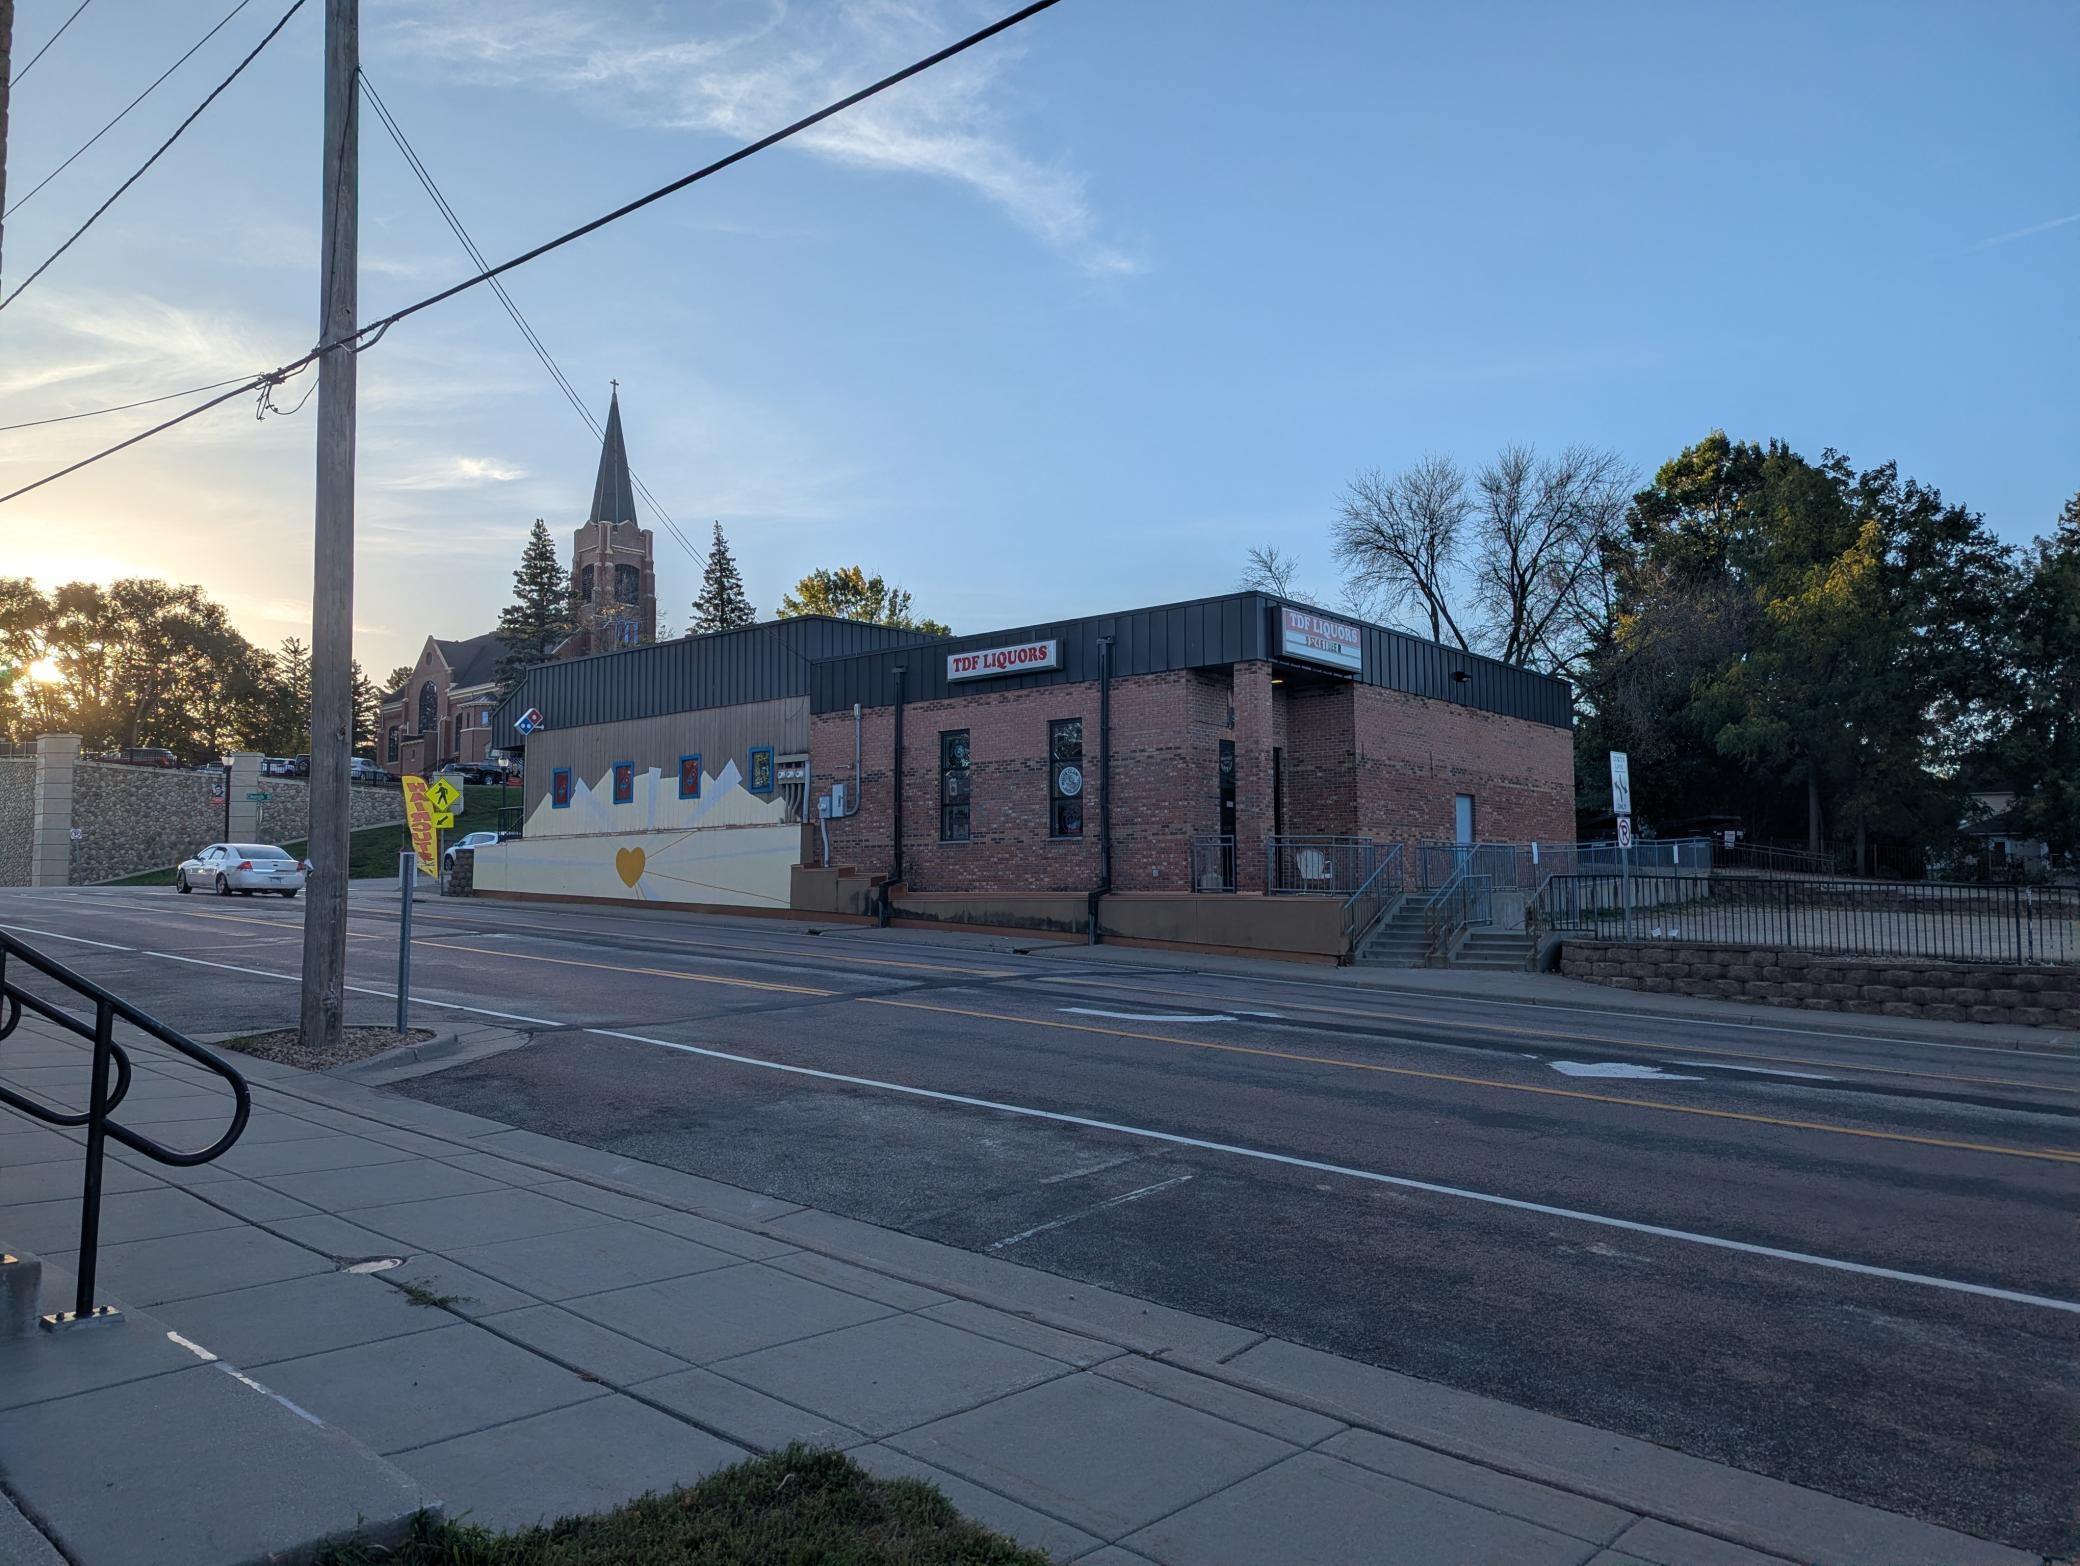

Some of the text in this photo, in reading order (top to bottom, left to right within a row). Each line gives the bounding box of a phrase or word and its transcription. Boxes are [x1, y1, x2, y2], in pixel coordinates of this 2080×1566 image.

[1290, 613, 1358, 642] TDF LIQUORS
[953, 645, 1048, 672] TDF LIQUORS
